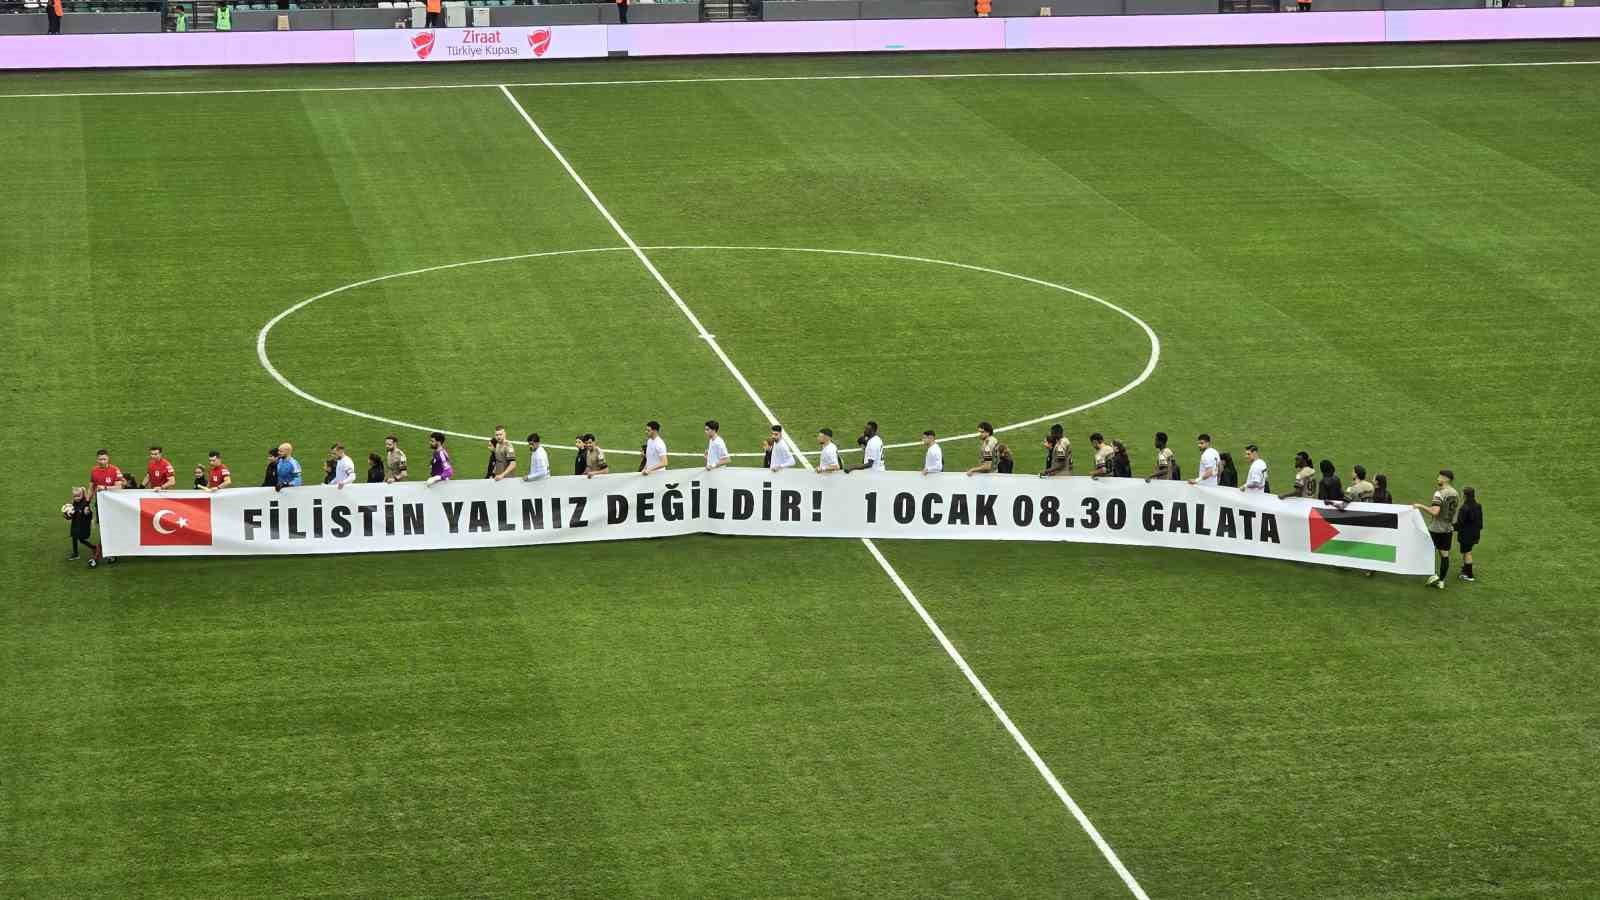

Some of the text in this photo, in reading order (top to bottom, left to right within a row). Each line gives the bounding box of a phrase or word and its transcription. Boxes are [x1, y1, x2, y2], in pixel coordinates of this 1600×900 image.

[462, 29, 501, 44] Ziraat
[447, 44, 518, 57] Türkiye Kupası
[243, 480, 1281, 545] FİLİSTİN YALNIZ DEĞİLDİR! 1 OCAK 08.30 GALATA
